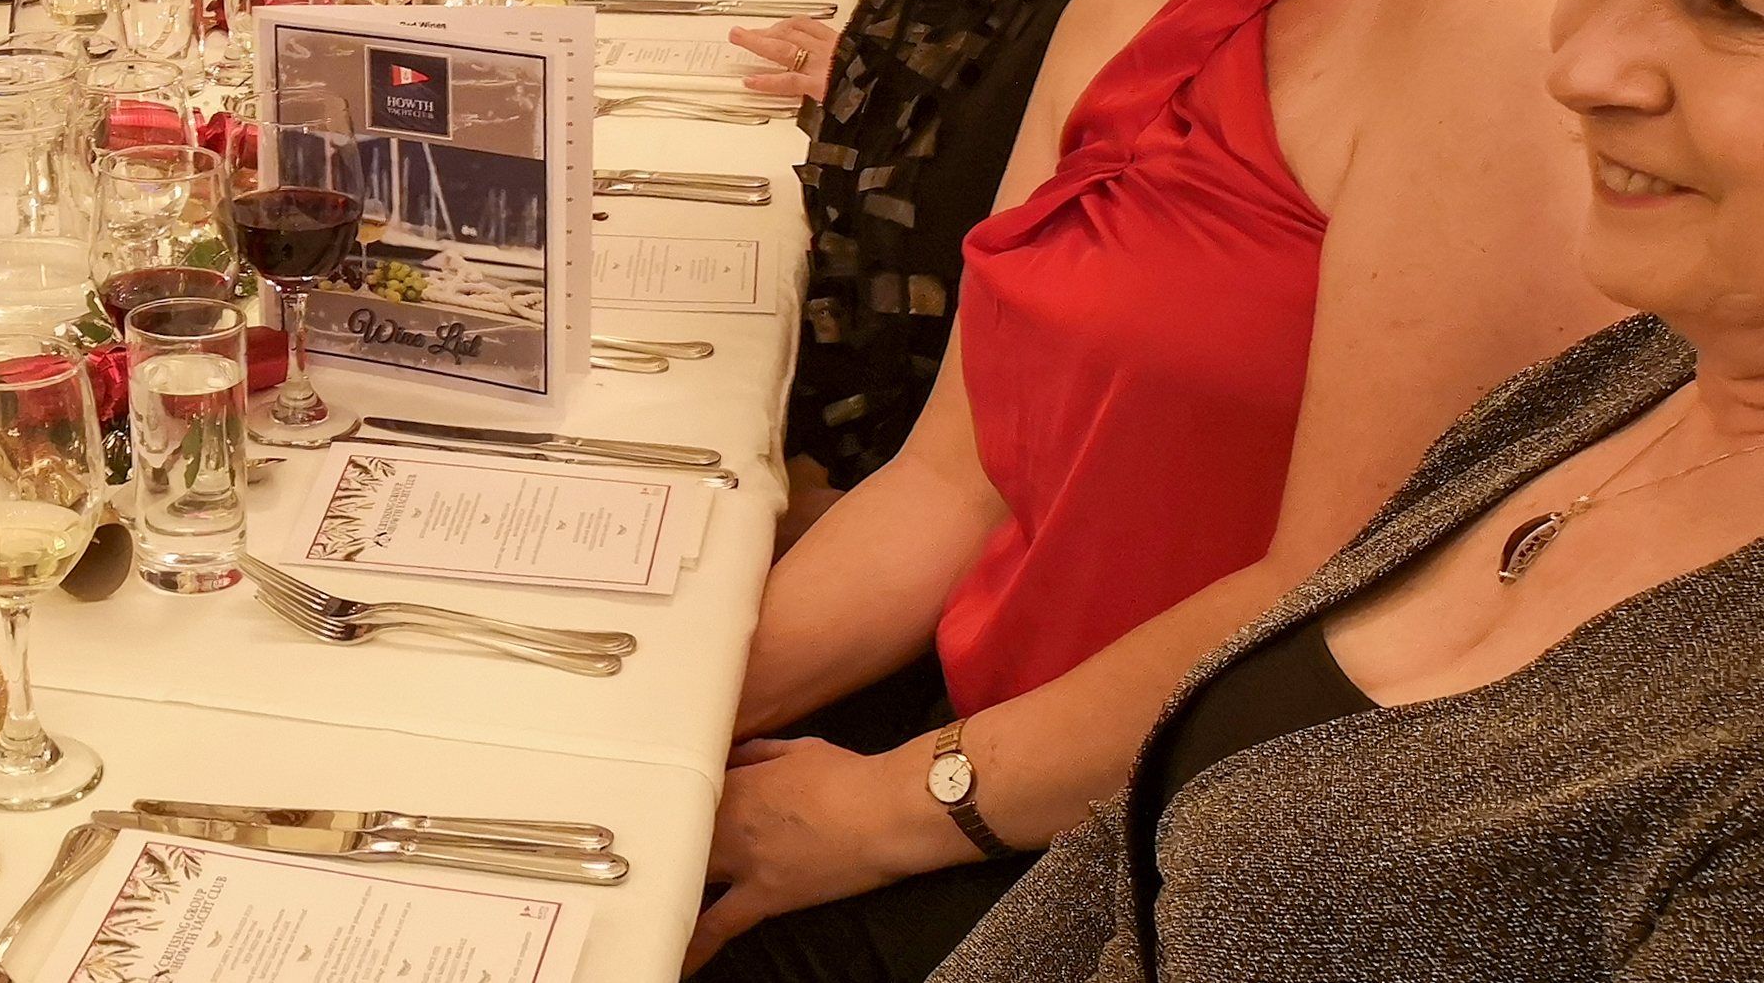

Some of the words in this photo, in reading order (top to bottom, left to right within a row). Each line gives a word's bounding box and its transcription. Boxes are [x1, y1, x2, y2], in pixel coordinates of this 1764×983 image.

[386, 95, 434, 112] HOWTH
[387, 107, 412, 117] YACHT
[348, 308, 427, 348] Wine
[428, 322, 483, 365] List
[158, 921, 189, 967] CRUISING
[183, 888, 207, 922] GROUP
[171, 932, 199, 972] HOWTH
[191, 901, 215, 931] YACHT
[207, 876, 227, 900] CLUB
